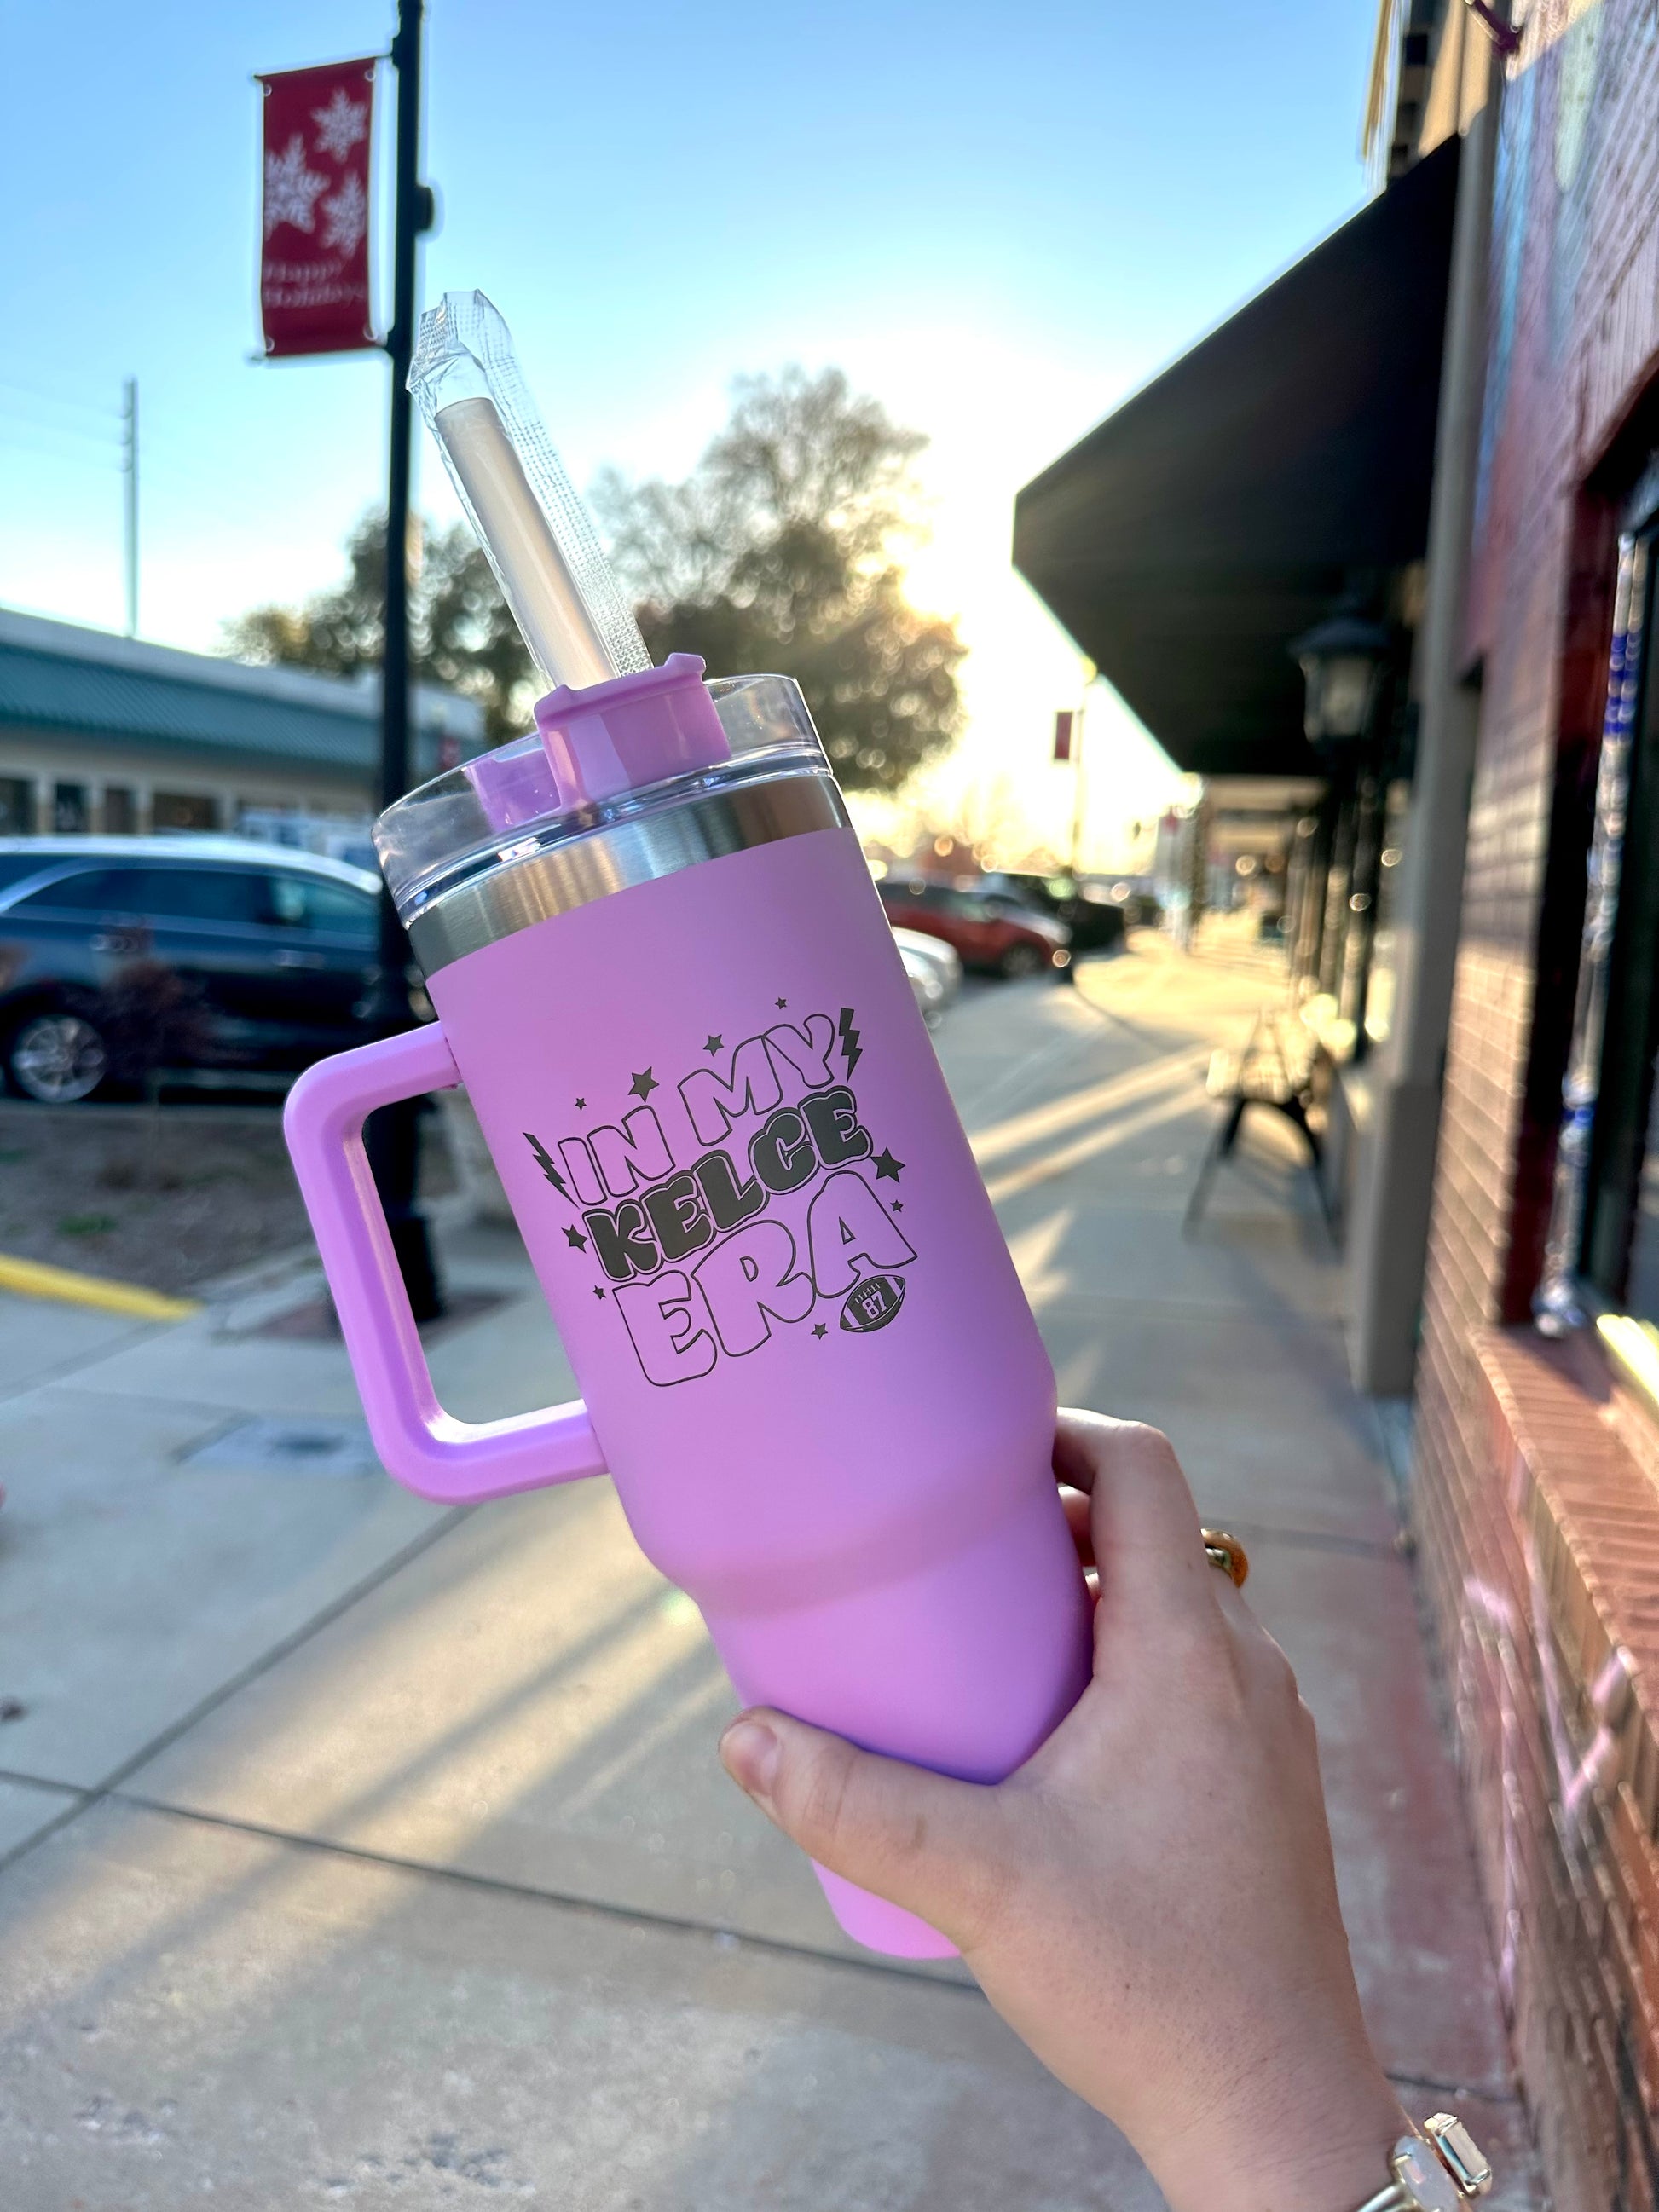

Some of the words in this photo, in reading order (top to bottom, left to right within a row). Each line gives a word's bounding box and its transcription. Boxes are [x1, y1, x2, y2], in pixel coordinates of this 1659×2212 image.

[558, 1105, 676, 1205] IN
[678, 1014, 835, 1147] MY
[582, 1085, 874, 1283] KELCE
[612, 1170, 917, 1387] ERA
[861, 1291, 887, 1319] 87
